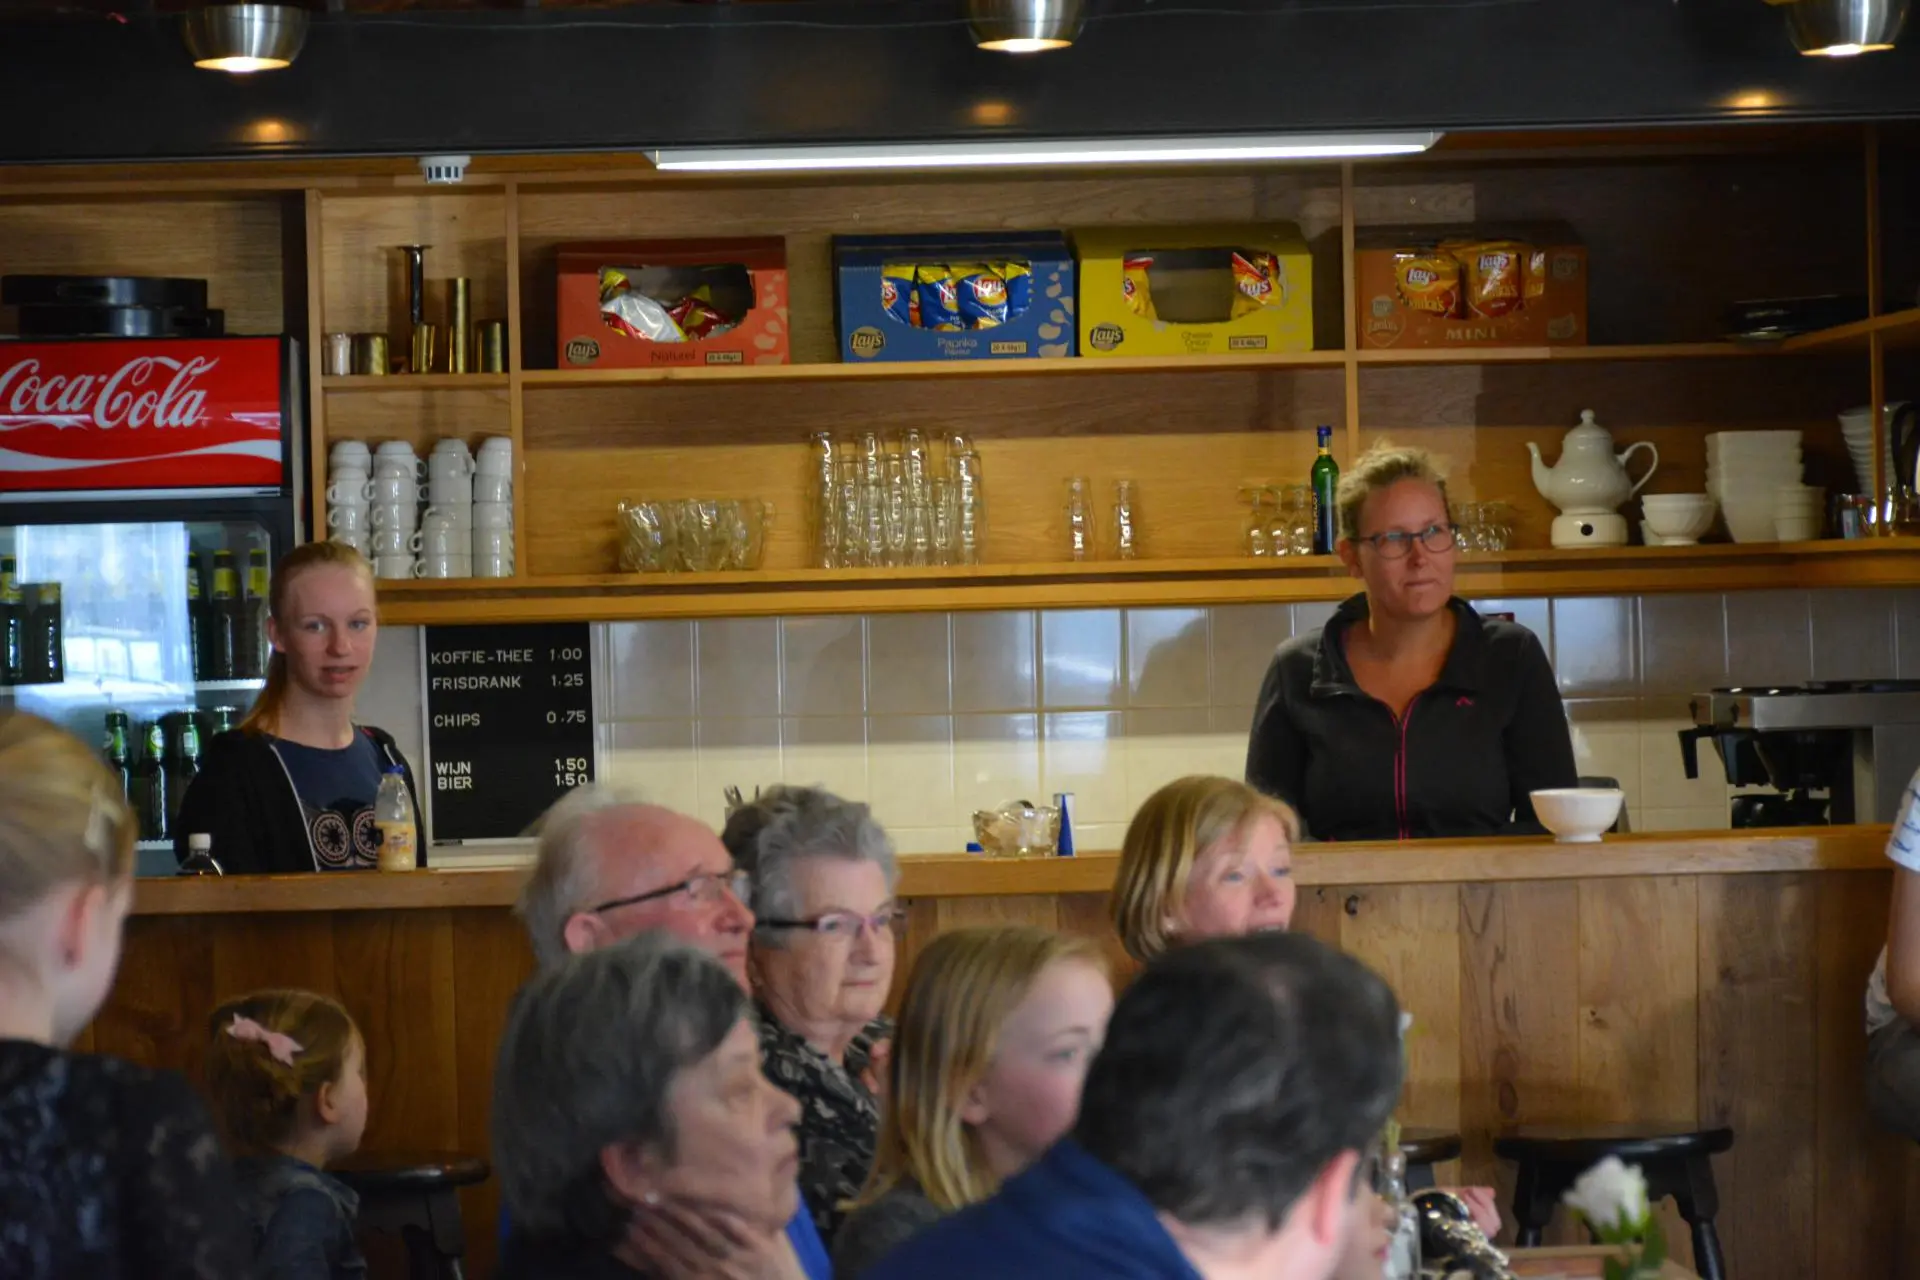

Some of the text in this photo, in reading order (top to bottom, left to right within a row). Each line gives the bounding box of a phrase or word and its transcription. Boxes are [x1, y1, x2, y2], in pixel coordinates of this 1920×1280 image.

[550, 648, 583, 662] 1.00
[432, 673, 584, 690] FRISDRANK 1.25
[434, 713, 481, 727] CHIPS
[435, 758, 587, 775] WIJN 1.50
[437, 773, 588, 790] BIER 1.50
